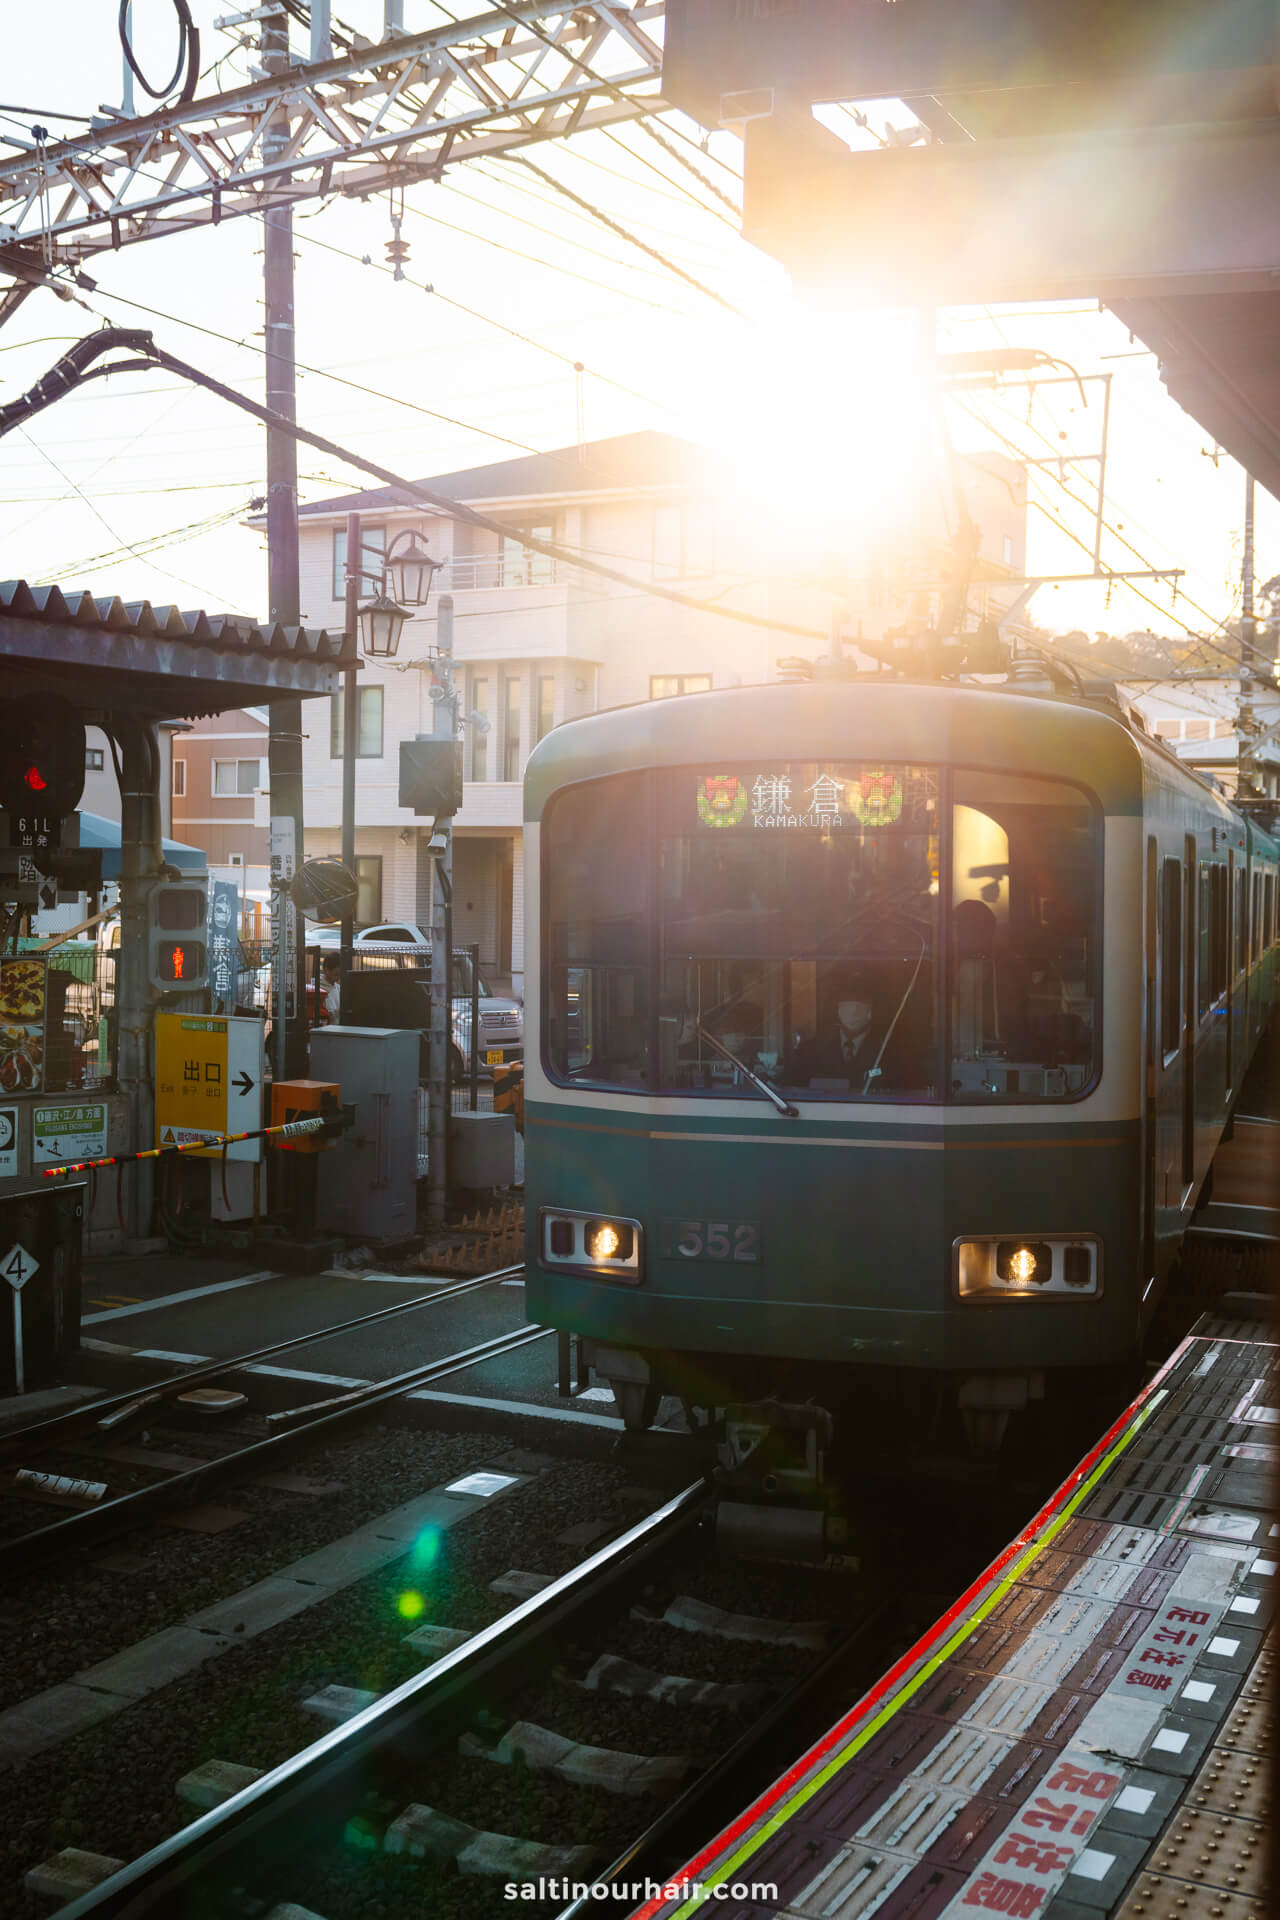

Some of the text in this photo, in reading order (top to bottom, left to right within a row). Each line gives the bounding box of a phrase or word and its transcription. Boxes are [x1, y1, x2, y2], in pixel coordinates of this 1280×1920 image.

[752, 774, 845, 813] 鎌倉
[754, 815, 842, 828] KAMAKURA
[22, 834, 49, 848] 出発
[183, 1059, 221, 1083] 出口
[6, 1250, 27, 1279] 4
[1126, 1606, 1211, 1691] 足元注意
[962, 1761, 1121, 1919] 足元注意
